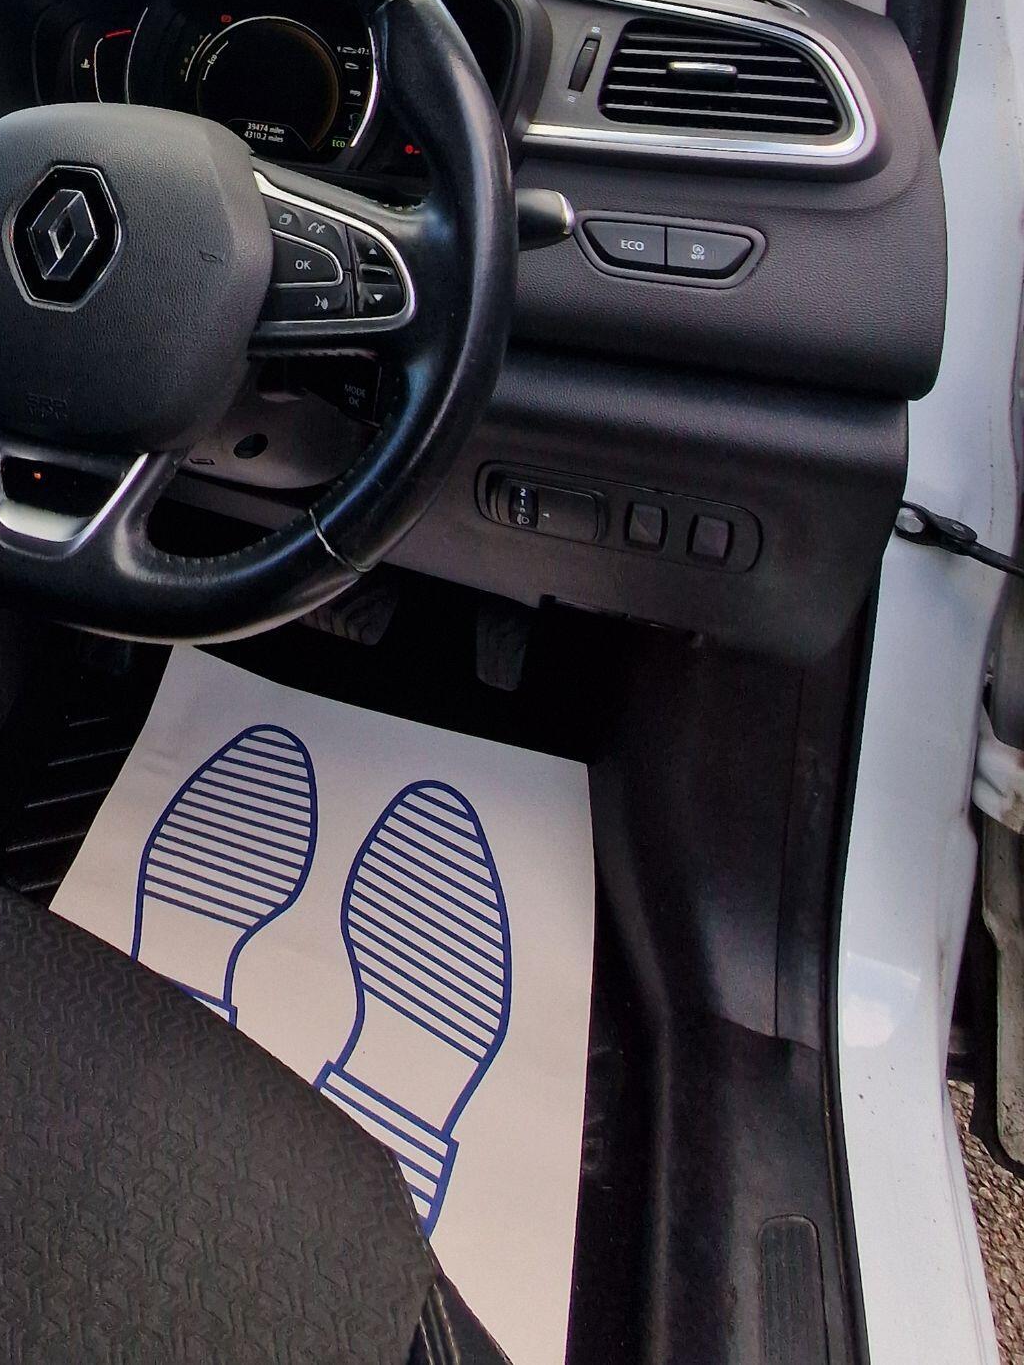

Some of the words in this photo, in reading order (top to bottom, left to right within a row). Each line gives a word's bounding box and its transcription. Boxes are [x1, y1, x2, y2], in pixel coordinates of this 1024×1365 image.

[269, 125, 285, 135] miles
[268, 134, 284, 143] miles
[332, 139, 346, 148] ECO
[620, 239, 645, 251] ECO
[295, 260, 312, 271] OK
